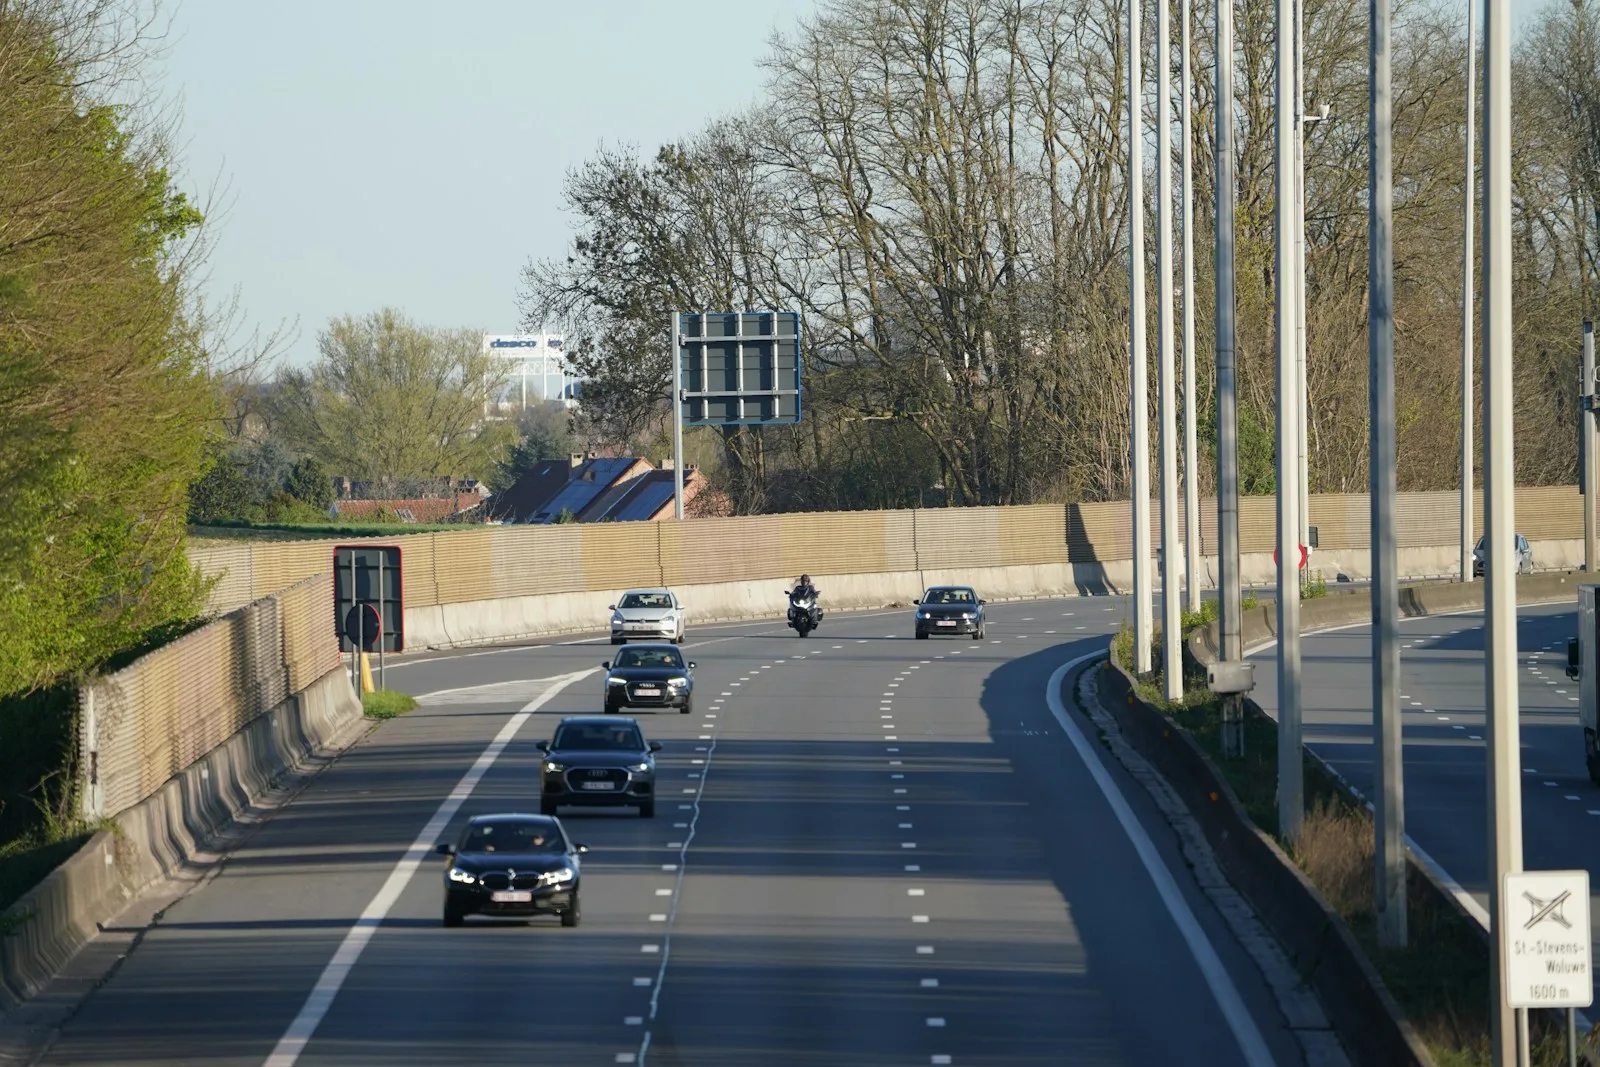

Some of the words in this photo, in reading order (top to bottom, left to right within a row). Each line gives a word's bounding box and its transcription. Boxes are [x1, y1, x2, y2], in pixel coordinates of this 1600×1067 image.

[1546, 959, 1586, 974] Woluwe
[1530, 985, 1557, 1000] 1600
[1559, 988, 1569, 999] m
